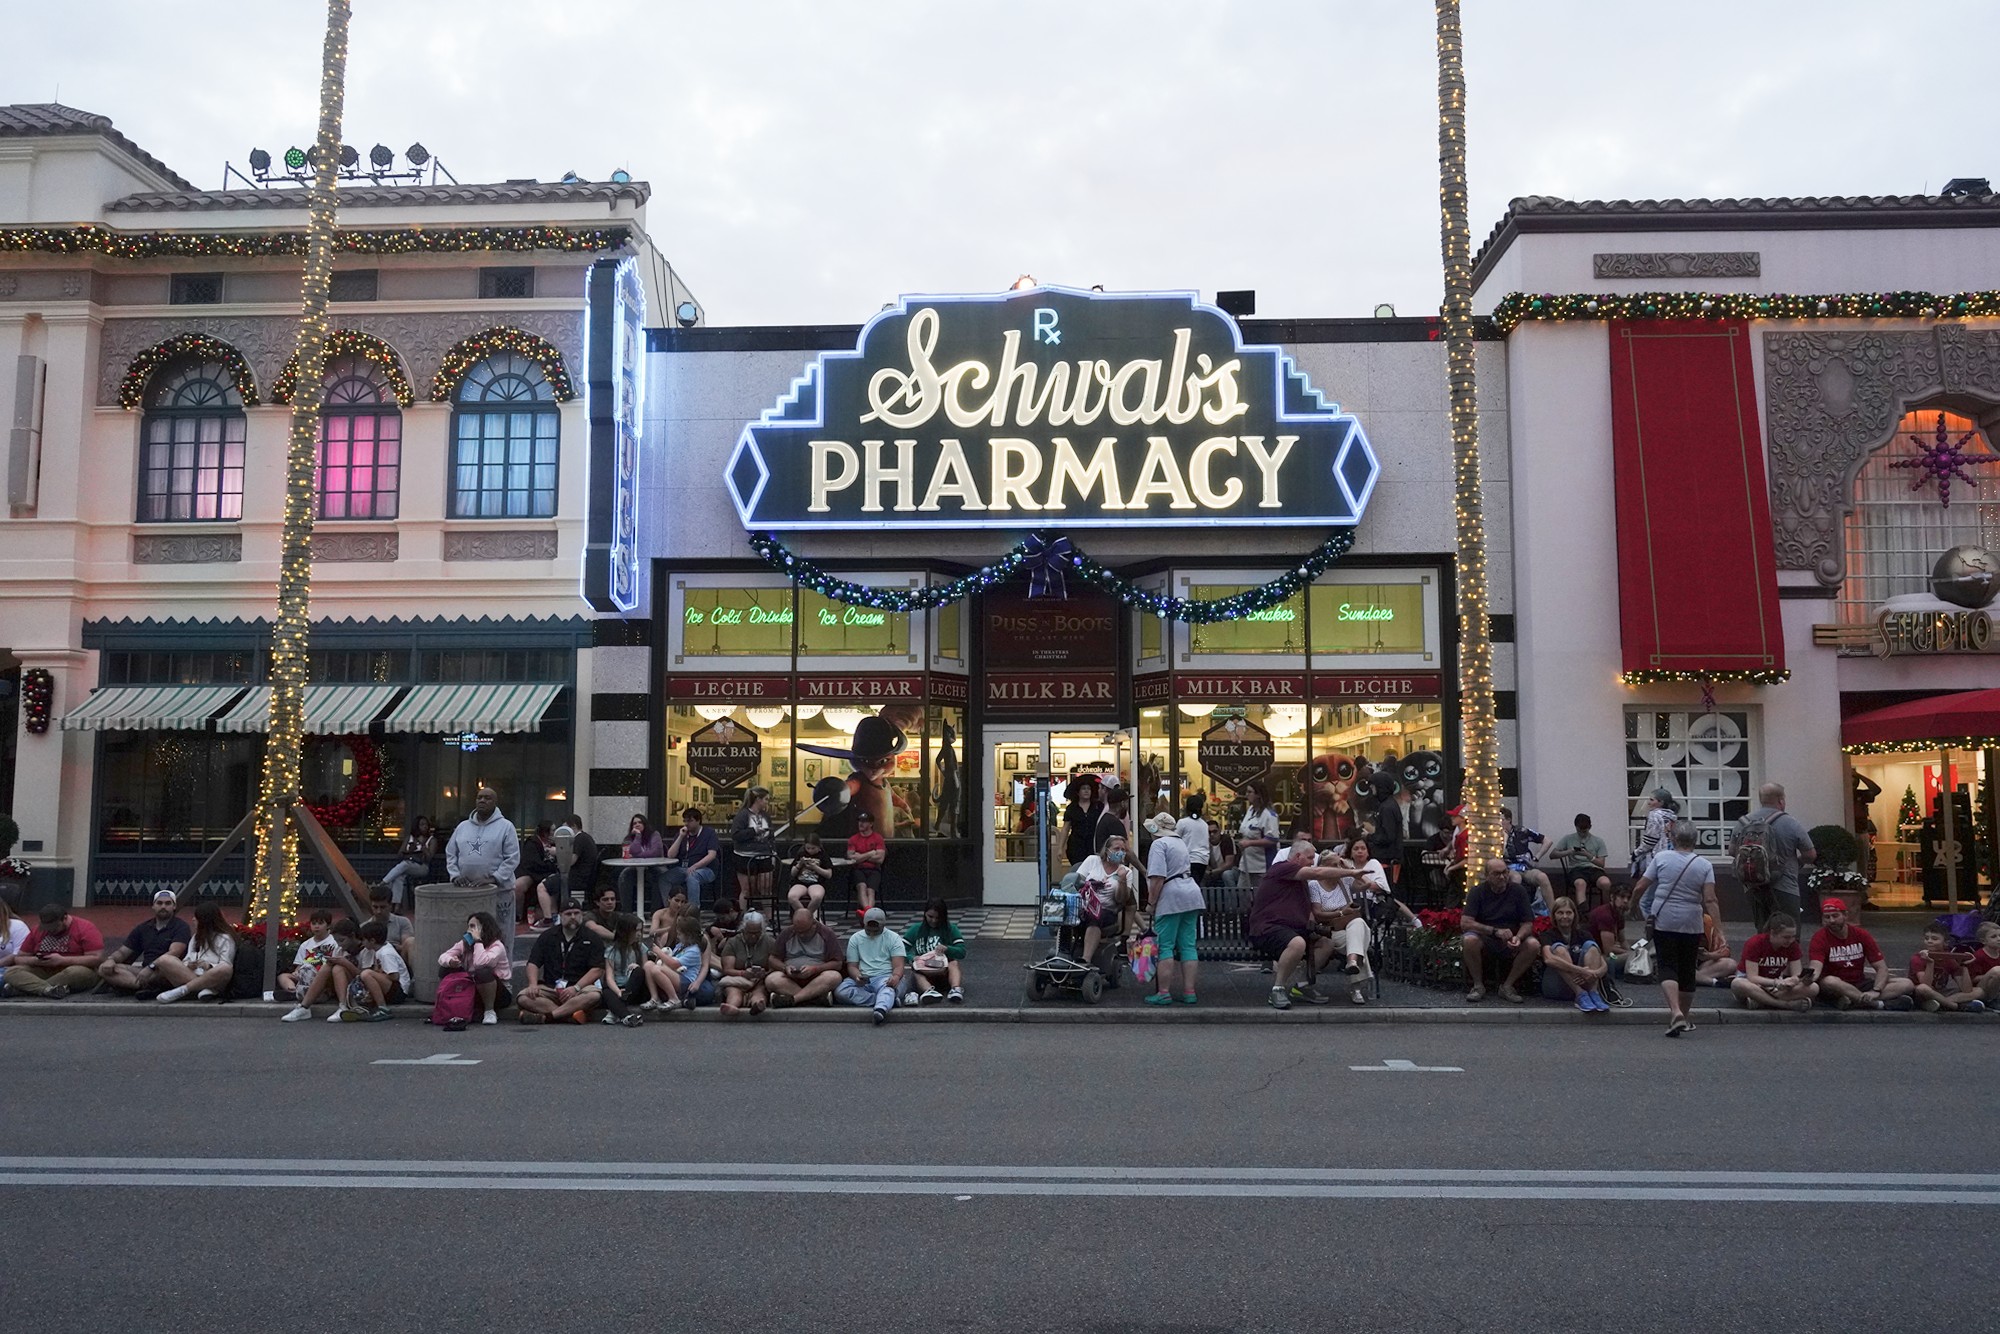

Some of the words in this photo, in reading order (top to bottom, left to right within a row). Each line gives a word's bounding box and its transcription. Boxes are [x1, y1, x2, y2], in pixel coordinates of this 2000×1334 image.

[860, 307, 1249, 429] Schwab's
[807, 435, 1300, 512] PHARMACY
[684, 606, 704, 624] Ice
[710, 606, 742, 626] Cold
[750, 606, 794, 625] Drinks
[818, 608, 838, 626] Ice
[842, 606, 884, 626] Cream
[1338, 602, 1394, 622] Sundaes
[991, 614, 1038, 632] PUSS
[1054, 615, 1113, 632] BOOTS
[1877, 608, 1993, 660] STUDIO
[694, 682, 764, 696] LECHE
[809, 682, 864, 696] MILK
[869, 682, 912, 696] BAR
[930, 682, 968, 698] LECHE
[988, 682, 1056, 699] MILK
[1062, 682, 1113, 699] BAR
[1134, 682, 1170, 698] LECHE
[1187, 680, 1244, 694] MILK
[1250, 680, 1294, 694] BAR
[1340, 680, 1413, 694] LECHE
[690, 746, 726, 758] MILK
[730, 746, 758, 758] BAR
[1202, 745, 1238, 756] MILK
[1242, 745, 1272, 756] BAR
